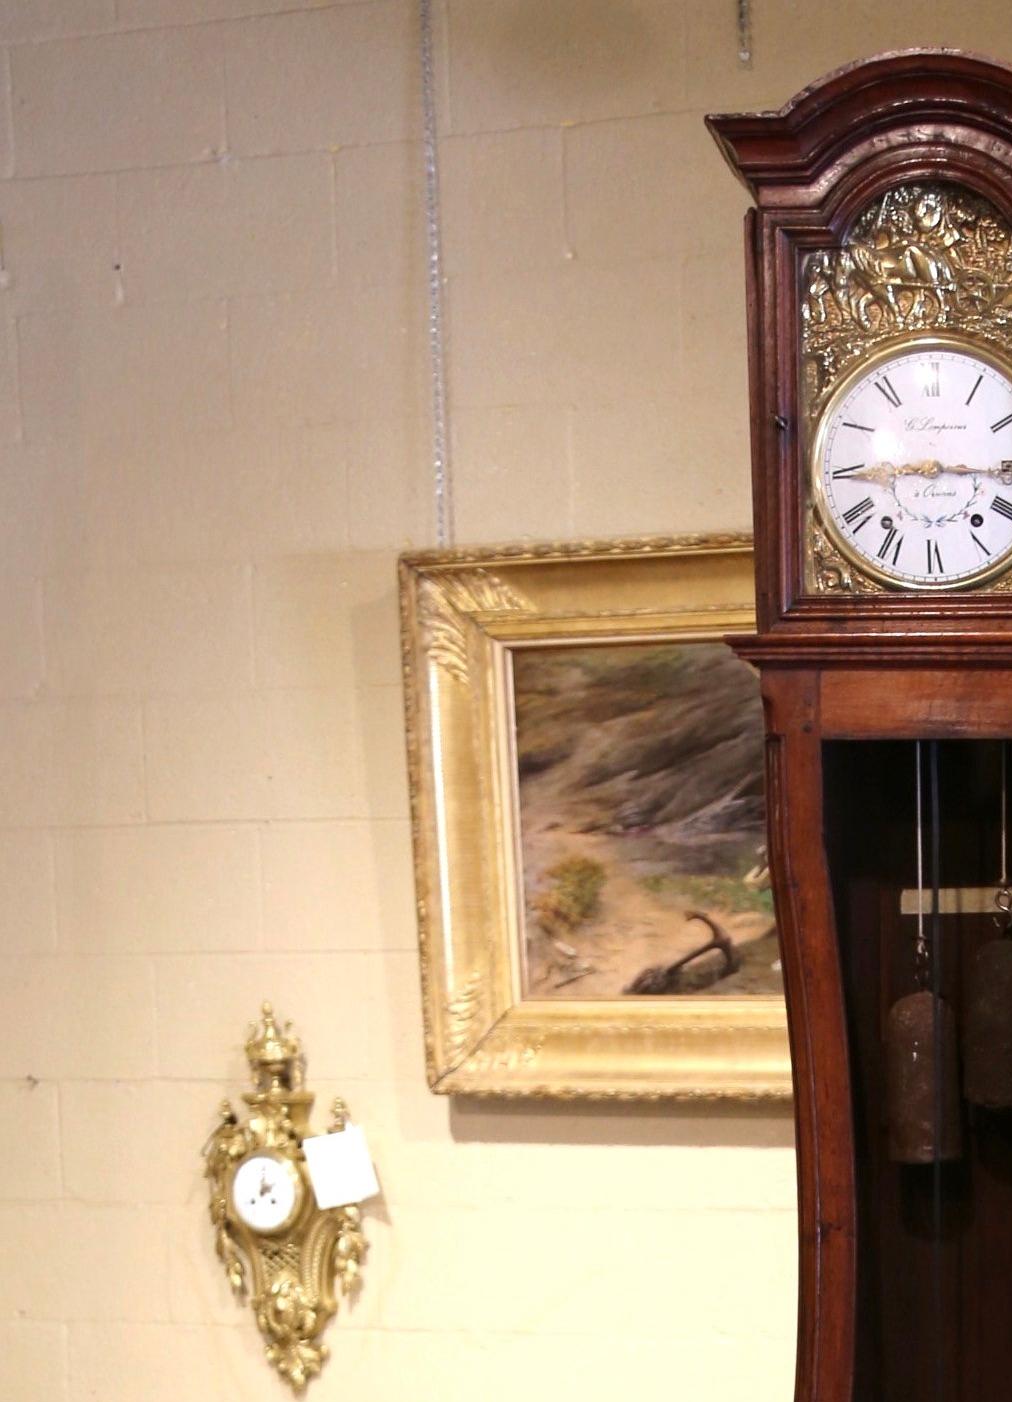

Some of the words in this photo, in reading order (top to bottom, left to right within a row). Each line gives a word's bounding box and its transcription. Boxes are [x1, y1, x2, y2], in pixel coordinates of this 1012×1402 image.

[874, 374, 904, 411] XI
[966, 374, 984, 406] I
[842, 497, 876, 535] VIII
[876, 527, 904, 566] VII
[926, 539, 944, 574] VI
[970, 530, 992, 560] V
